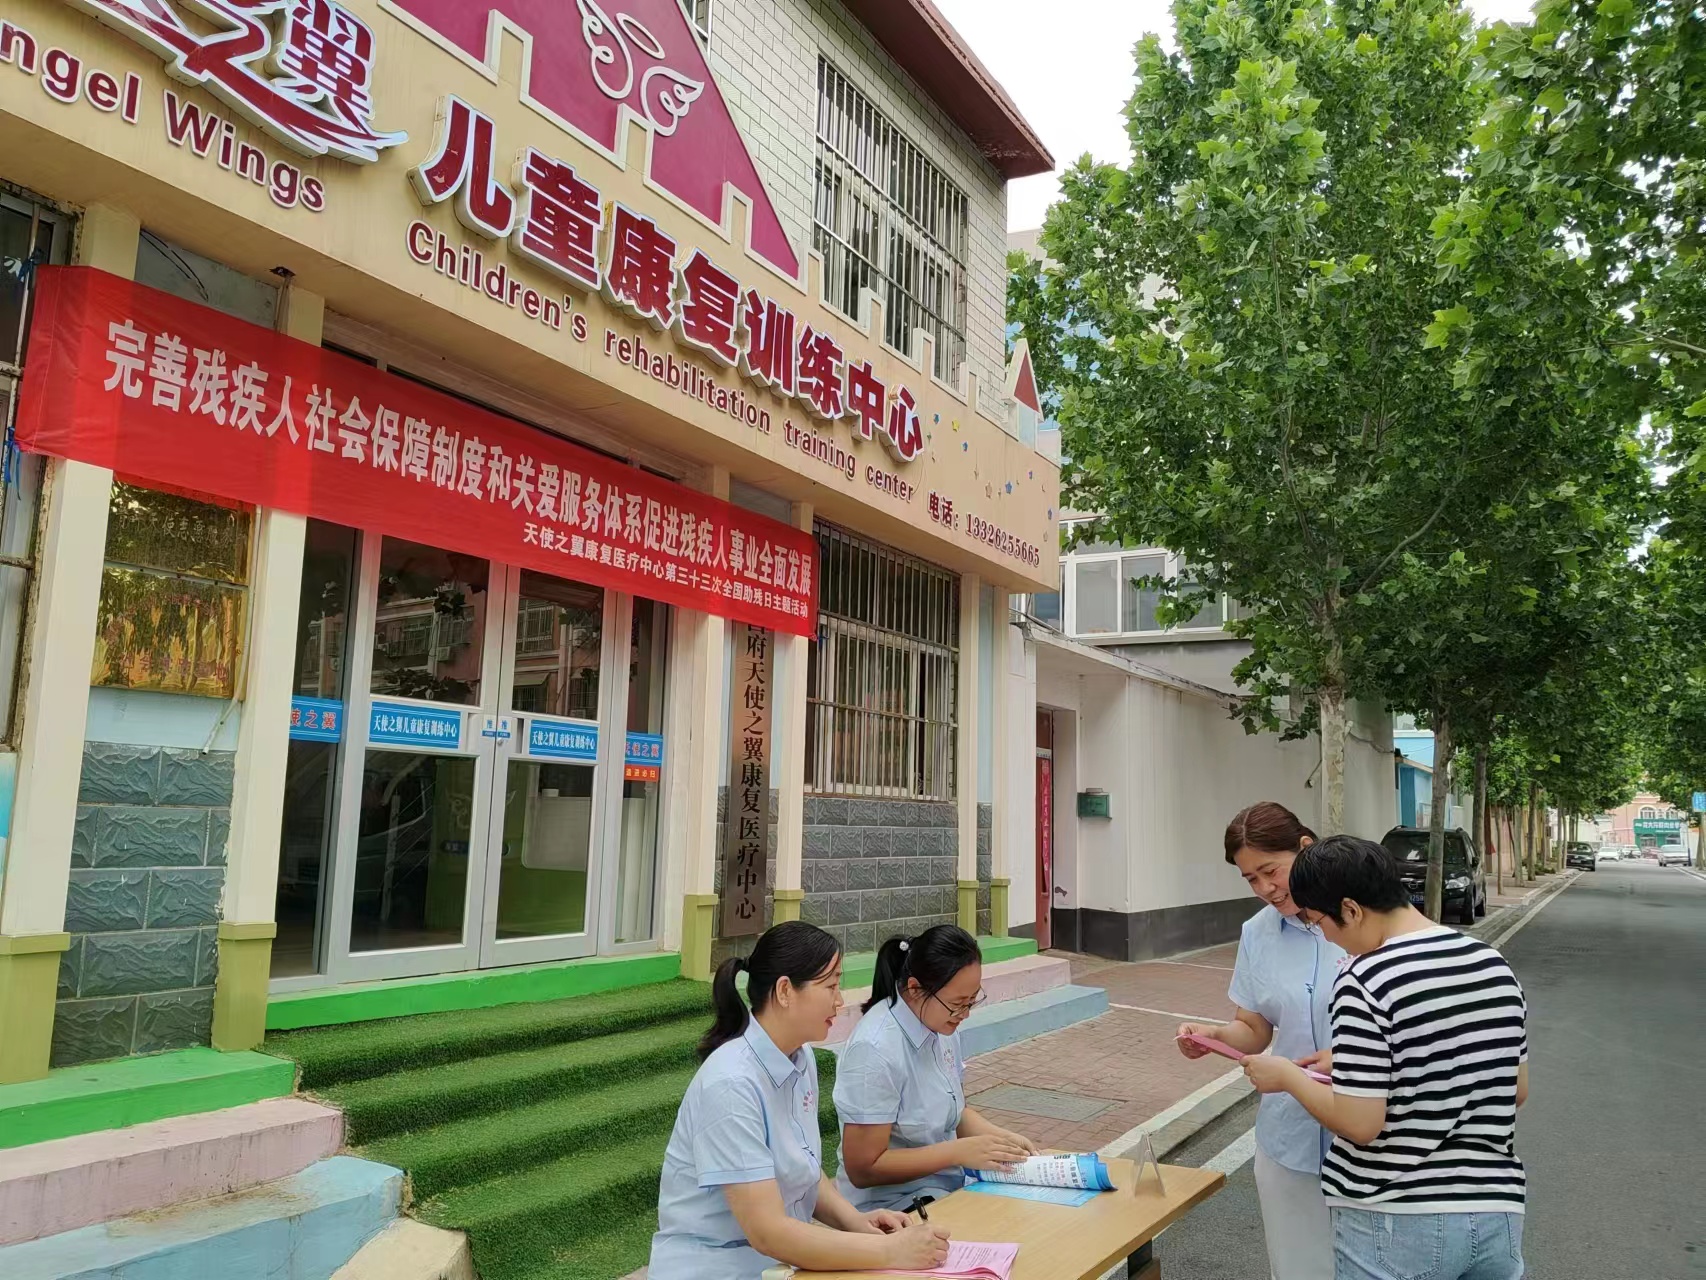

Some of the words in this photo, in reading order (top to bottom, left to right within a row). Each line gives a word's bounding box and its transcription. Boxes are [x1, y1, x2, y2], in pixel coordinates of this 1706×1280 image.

[163, 88, 326, 212] Wings
[416, 94, 924, 463] 儿童康复训练中心
[407, 219, 588, 342] Children's
[604, 327, 772, 435] rehabilitation
[784, 418, 857, 482] training
[865, 461, 915, 504] center
[104, 319, 811, 598] 完善残疾人社会保障制度和关爱服务体系促进残疾人事业全面发展
[523, 522, 808, 619] 天使之翼康复医疗中心第三十三次全国助残日主题活动
[966, 513, 1040, 567] 13326255665
[373, 714, 458, 737] 天使之翼儿童康复训练中心
[532, 730, 596, 750] 天使之翼儿童康复训练中心
